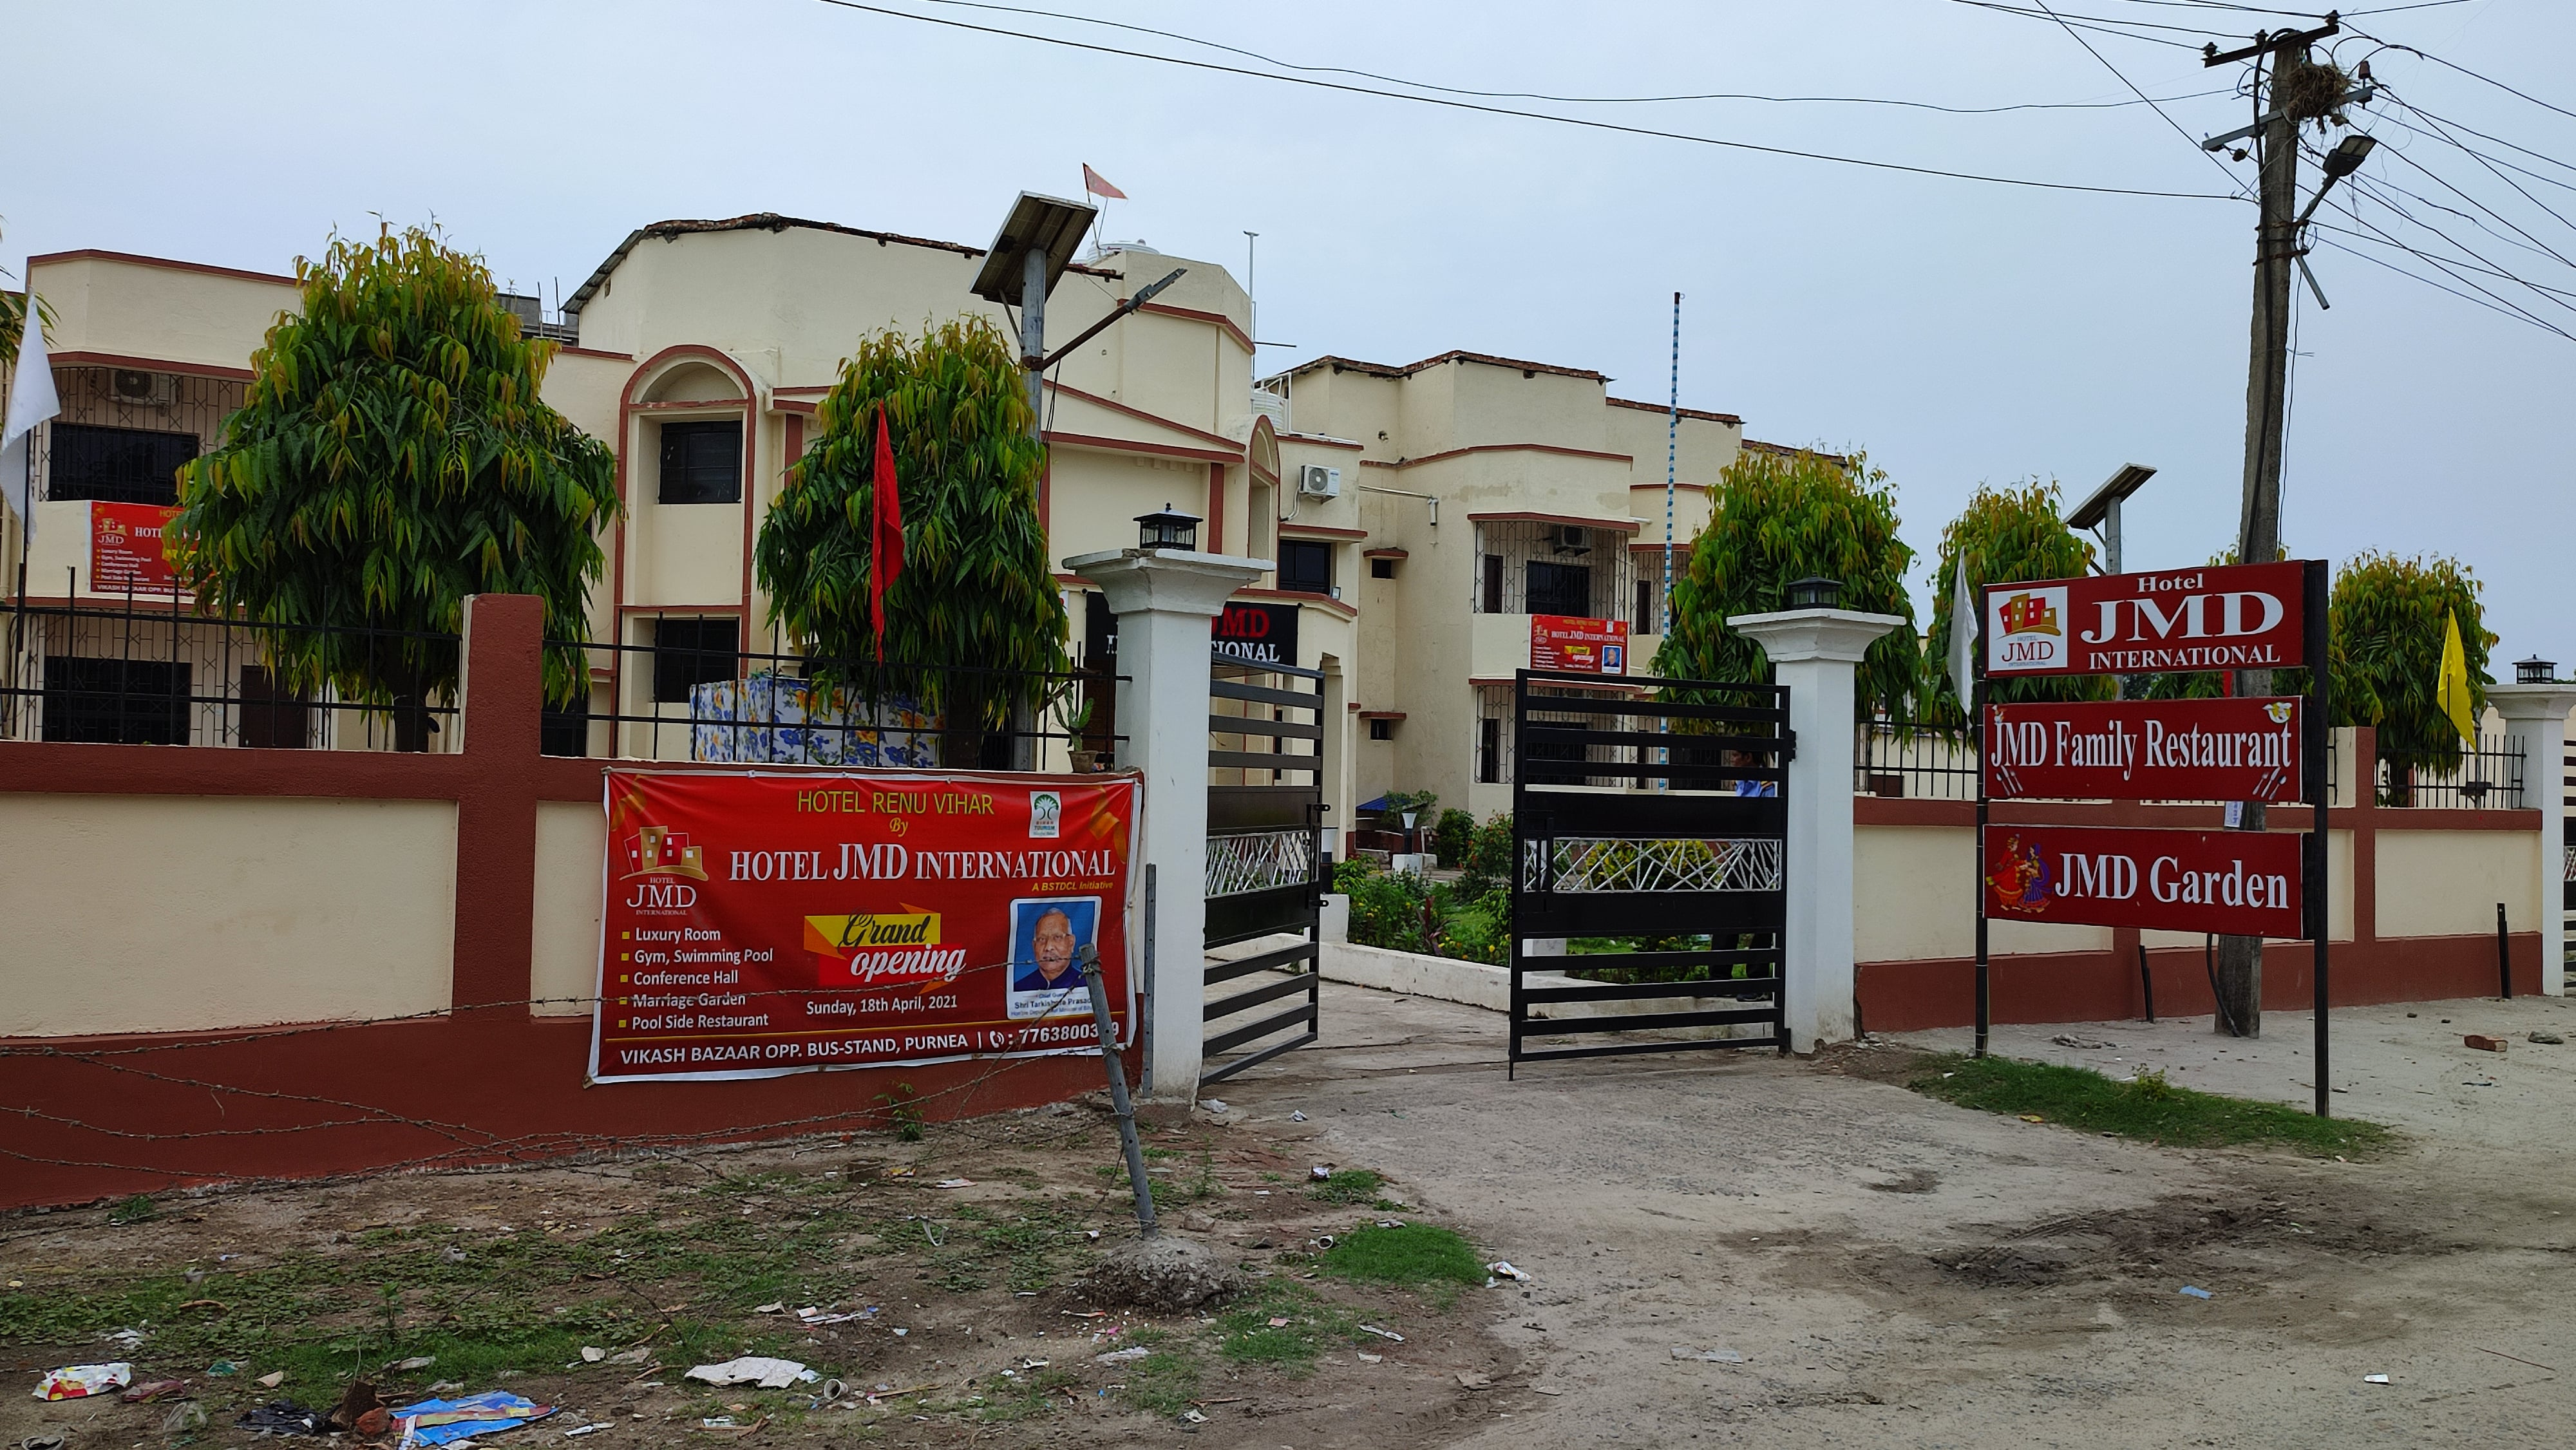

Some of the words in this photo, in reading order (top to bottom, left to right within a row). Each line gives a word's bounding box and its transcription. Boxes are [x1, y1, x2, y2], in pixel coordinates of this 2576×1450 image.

[98, 536, 124, 544] JMD
[2137, 573, 2204, 592] Hotel
[2080, 592, 2284, 644] JMD
[2002, 641, 2054, 662] JMD
[2088, 644, 2280, 670] INTERNATIONAL
[1991, 721, 2047, 767] JMD
[2054, 720, 2137, 781] Family
[2144, 720, 2292, 767] Restaurant
[797, 791, 865, 813] HOTEL
[873, 792, 927, 814] RENU
[934, 793, 994, 815] VIHAR
[889, 817, 908, 837] By
[728, 851, 828, 881] HOTEL
[833, 843, 908, 880] JMD
[914, 849, 1116, 880] INTERNATIONAL
[1032, 883, 1039, 892] A
[1041, 882, 1077, 891] BSTDCL
[1079, 881, 1113, 890] Initiative
[2055, 853, 2137, 899] JMD
[2150, 856, 2289, 909] Garden
[626, 884, 697, 908] JMD
[636, 927, 681, 944] Luxury
[685, 928, 721, 941] Room
[838, 907, 931, 956] Grand
[634, 950, 670, 966] Gym,
[674, 948, 741, 965] Swimming
[744, 948, 773, 962] Pool
[851, 943, 966, 983] opening
[634, 971, 710, 985] Conference
[714, 970, 738, 984] Hall
[633, 993, 694, 1009] Marriage
[698, 992, 746, 1006] Garden
[806, 999, 857, 1017] Sunday,
[860, 998, 888, 1013] 18th
[891, 996, 925, 1013] April,
[929, 995, 957, 1009] 2021
[632, 1015, 661, 1030] Pool
[665, 1015, 694, 1028] Side
[698, 1013, 768, 1027] Restaurant
[621, 1048, 685, 1064] VIKASH
[692, 1046, 760, 1061] BAZAAR
[766, 1044, 802, 1059] OPP.
[808, 1039, 900, 1057] BUS-STAND,
[905, 1034, 969, 1051] PURNEA
[1019, 1021, 1119, 1044] 776380039
